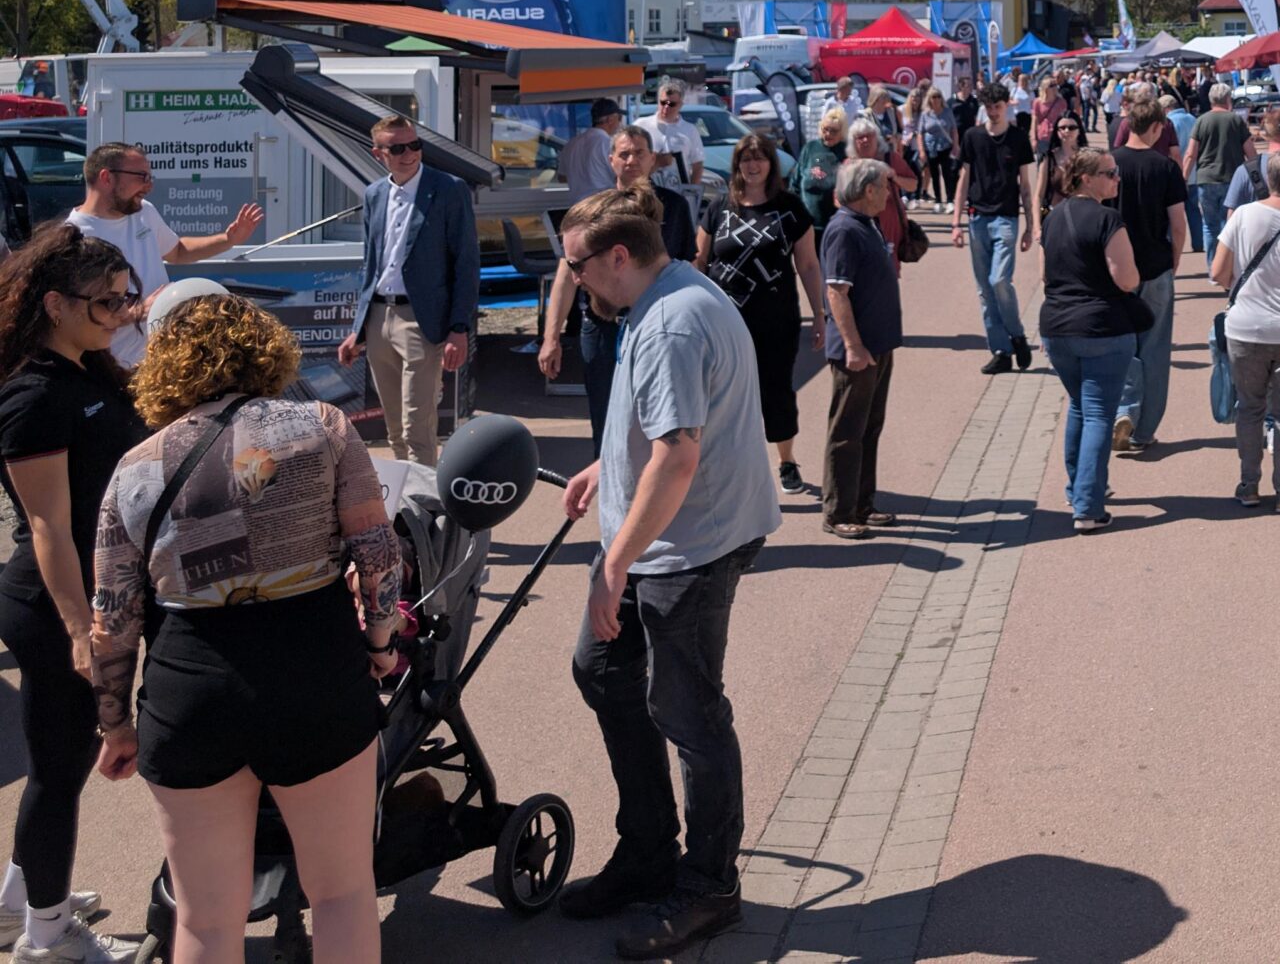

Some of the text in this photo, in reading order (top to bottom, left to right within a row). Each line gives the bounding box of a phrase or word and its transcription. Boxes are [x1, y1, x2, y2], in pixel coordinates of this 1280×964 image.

[162, 94, 200, 107] HEIM
[204, 94, 214, 106] &
[150, 156, 247, 170] und ums Haus
[168, 188, 223, 201] Beratung
[162, 204, 228, 216] Produktion
[170, 220, 222, 234] Montage
[314, 306, 338, 320] auf
[186, 555, 226, 582] THE
